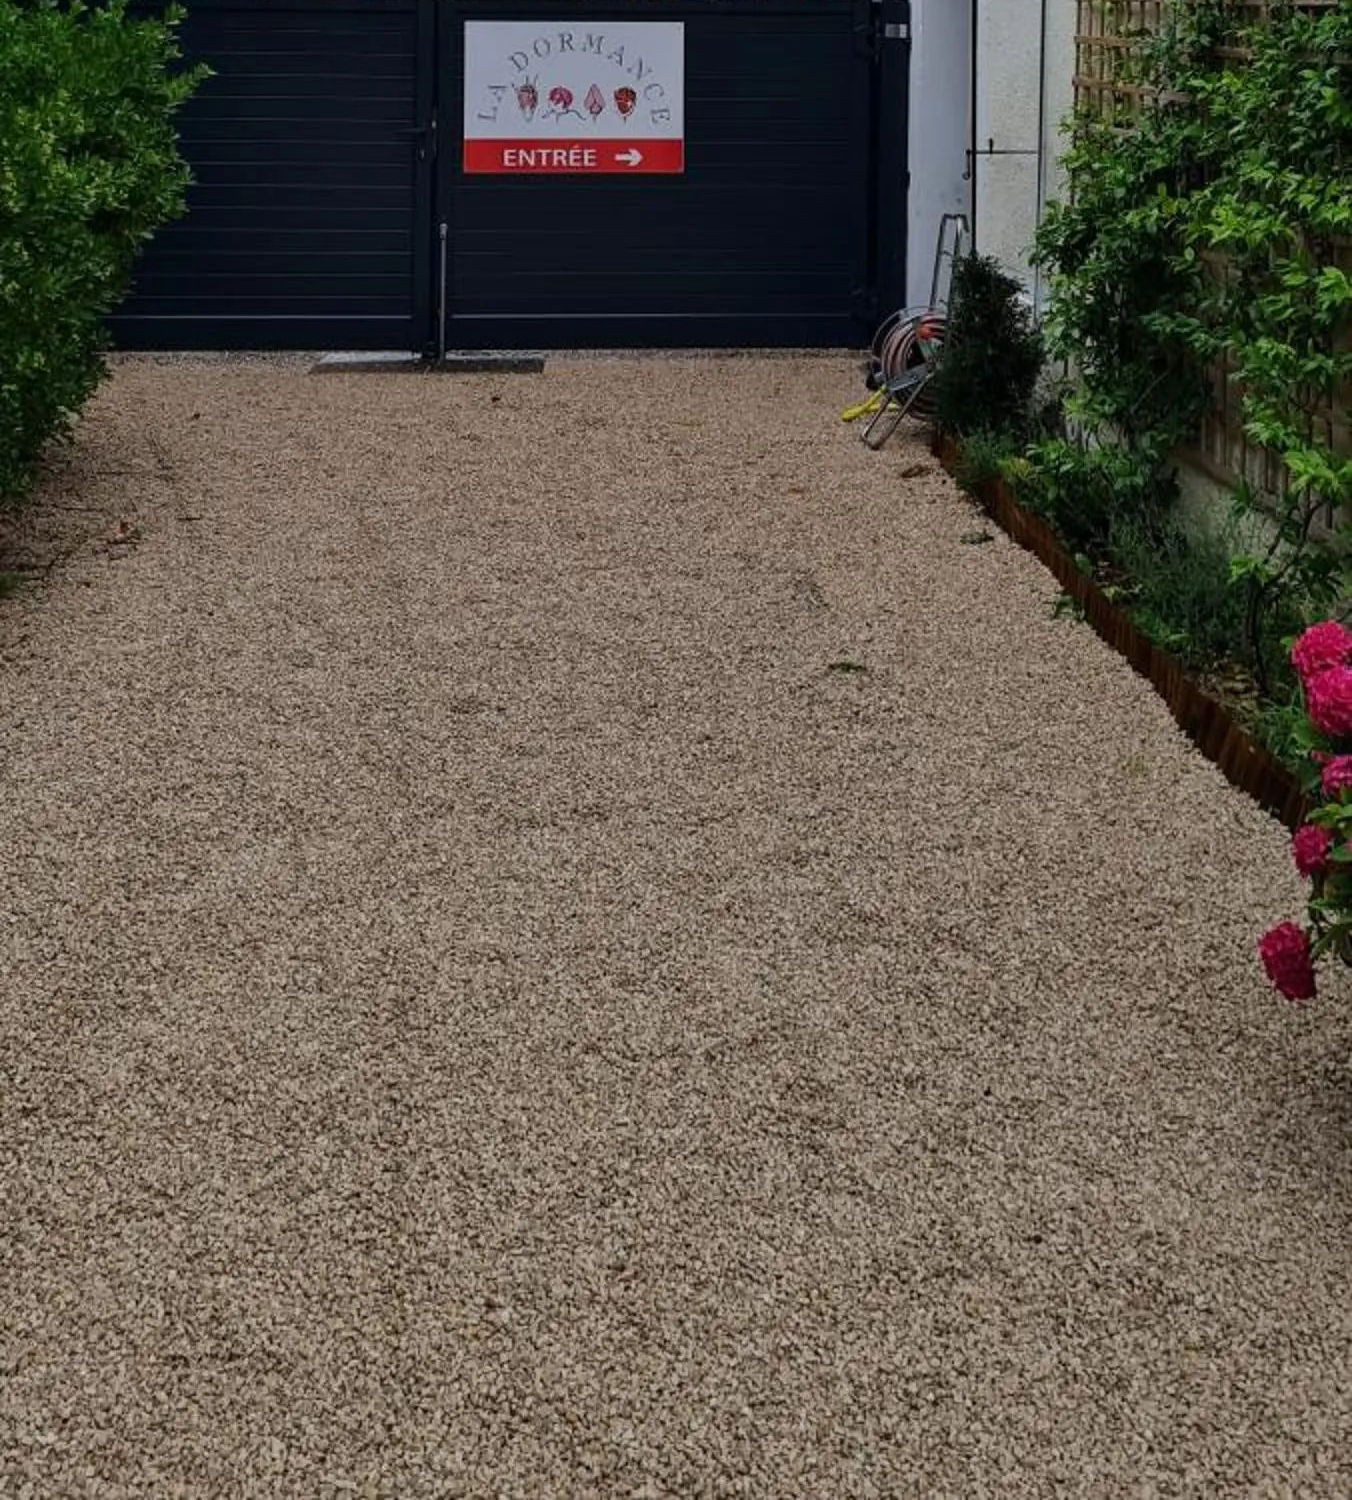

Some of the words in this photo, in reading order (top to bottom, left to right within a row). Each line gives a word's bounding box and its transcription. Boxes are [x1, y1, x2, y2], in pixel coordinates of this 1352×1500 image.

[478, 84, 508, 123] LA
[508, 32, 671, 124] DORMANCE
[503, 145, 597, 167] ENTRÉE
